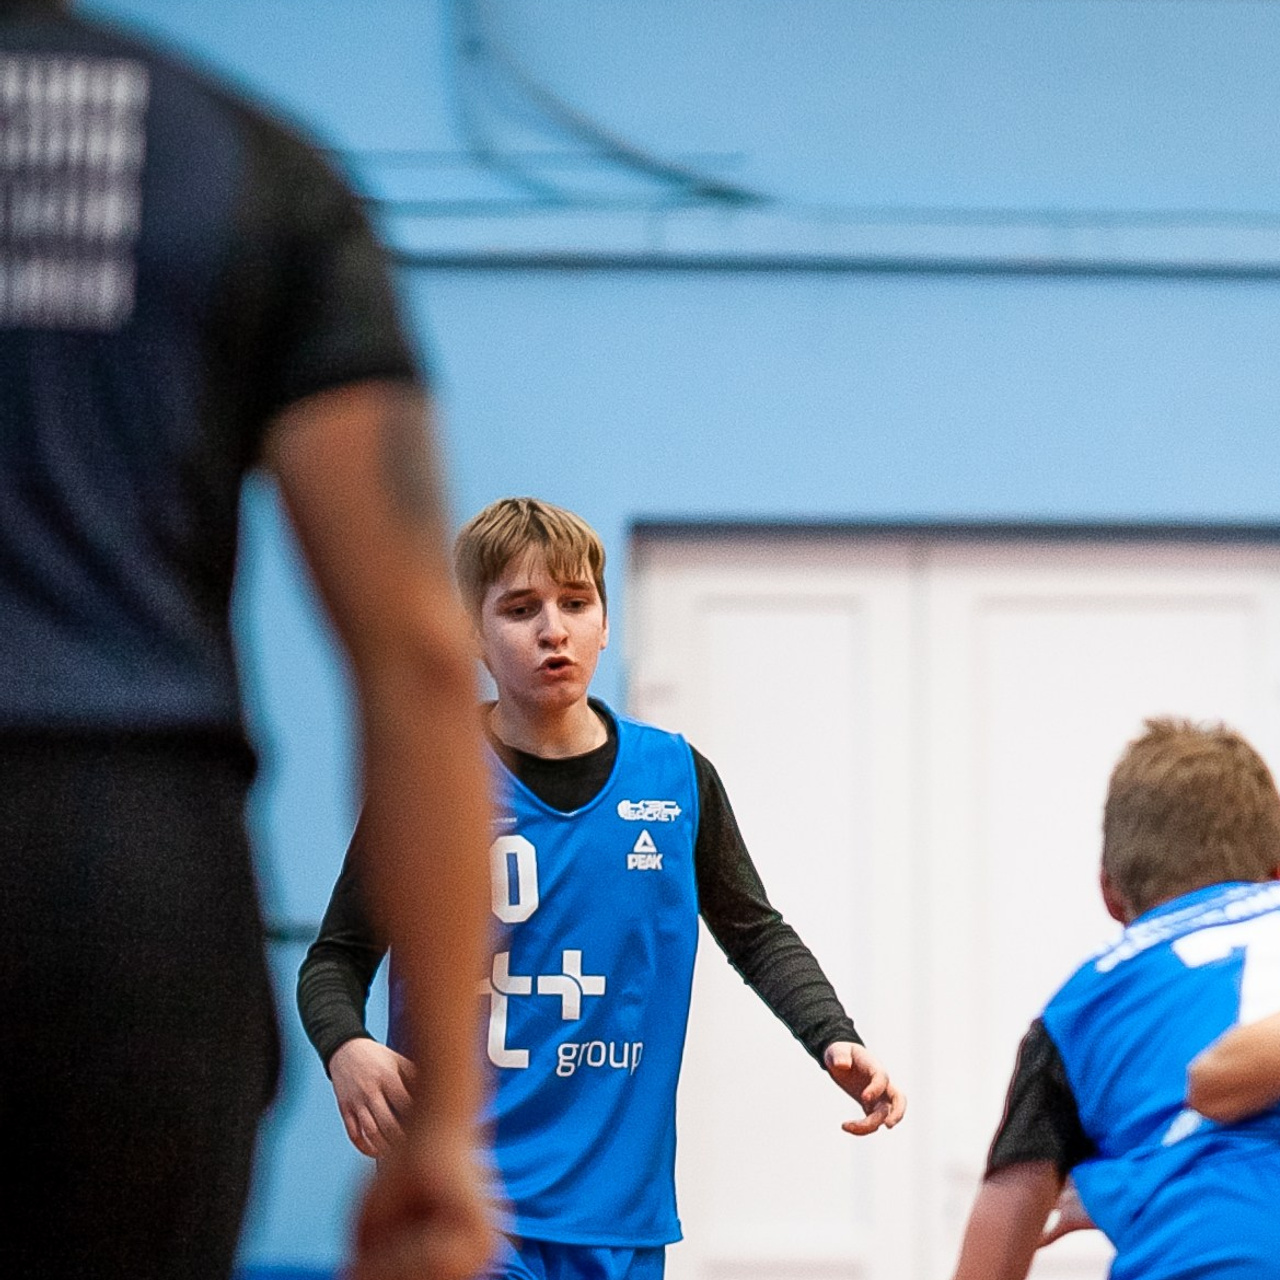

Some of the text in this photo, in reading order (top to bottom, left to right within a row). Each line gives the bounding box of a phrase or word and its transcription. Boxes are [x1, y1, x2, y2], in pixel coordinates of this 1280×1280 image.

[490, 835, 539, 923] 0
[627, 854, 663, 870] PEAK
[556, 1041, 643, 1078] group
